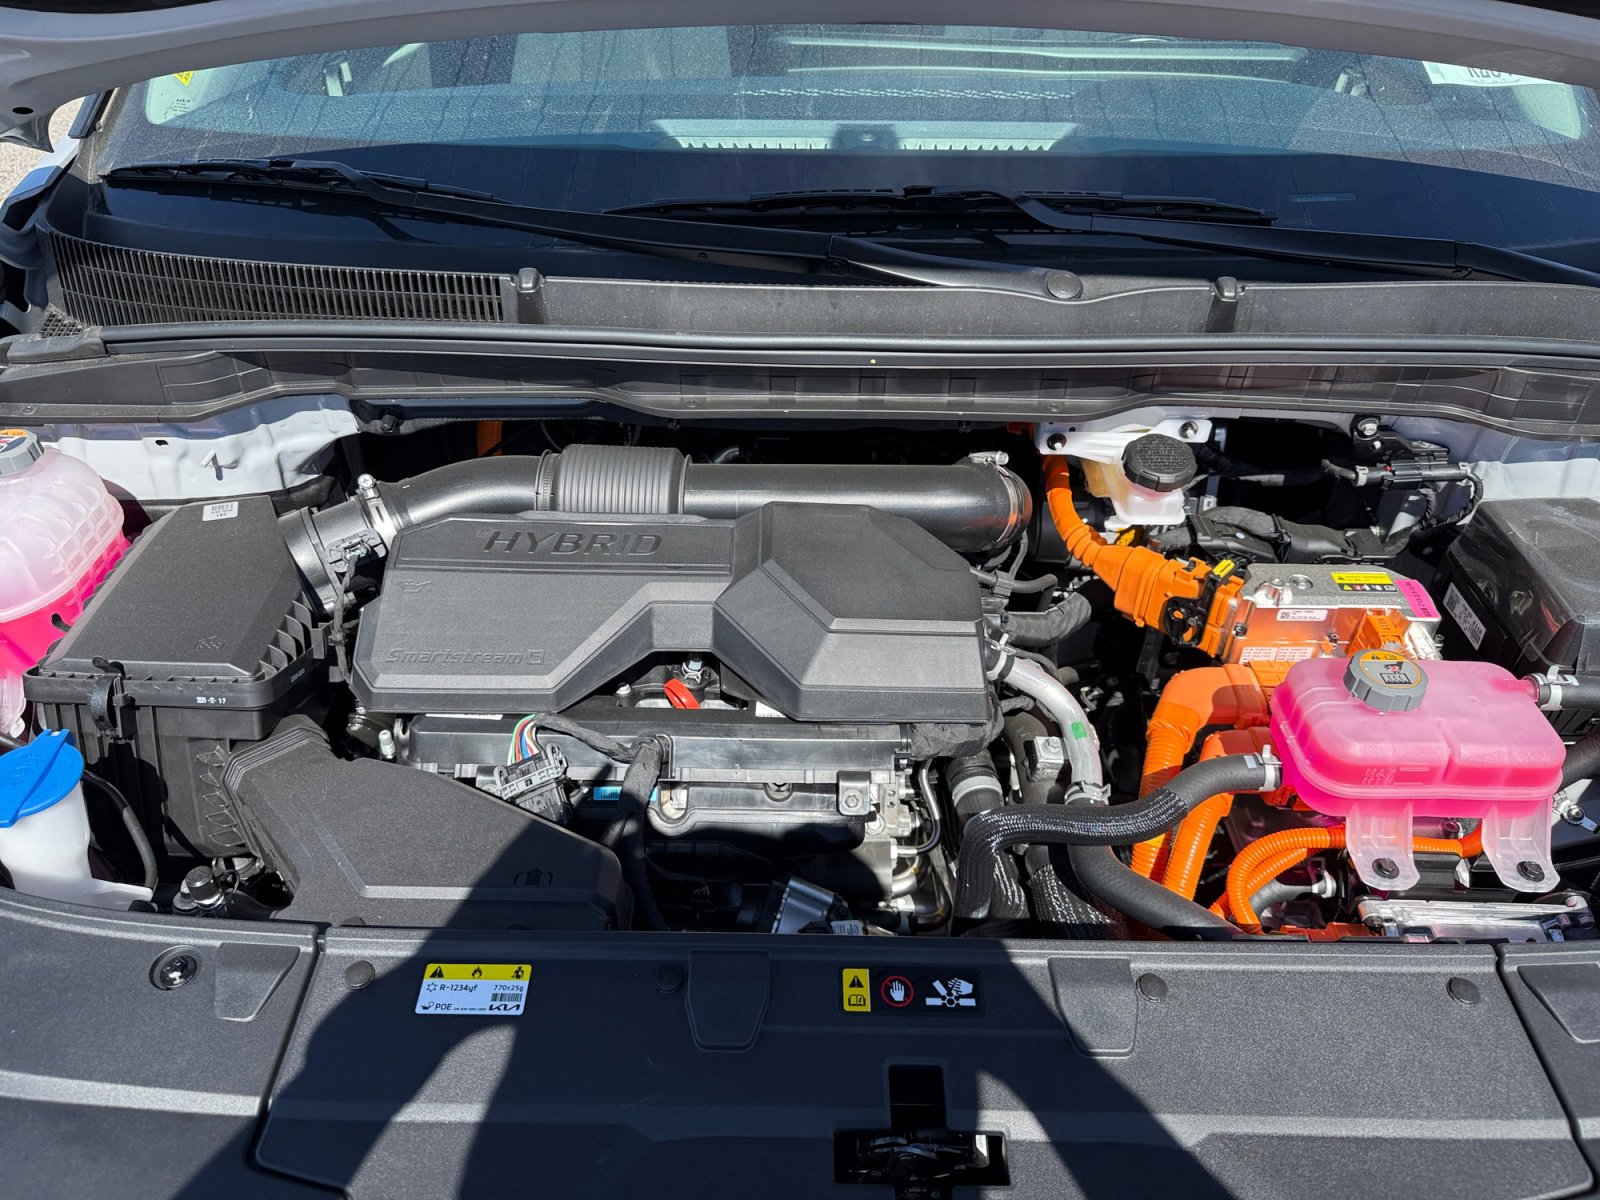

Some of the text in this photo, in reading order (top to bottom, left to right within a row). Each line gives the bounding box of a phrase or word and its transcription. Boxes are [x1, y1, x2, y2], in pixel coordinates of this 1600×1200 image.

[483, 530, 663, 556] HYBRID
[384, 648, 524, 664] Smartstream
[439, 983, 479, 993] R-1234yf
[493, 984, 524, 992] 770±25g
[434, 1003, 453, 1011] POE
[488, 1003, 521, 1011] KIA
